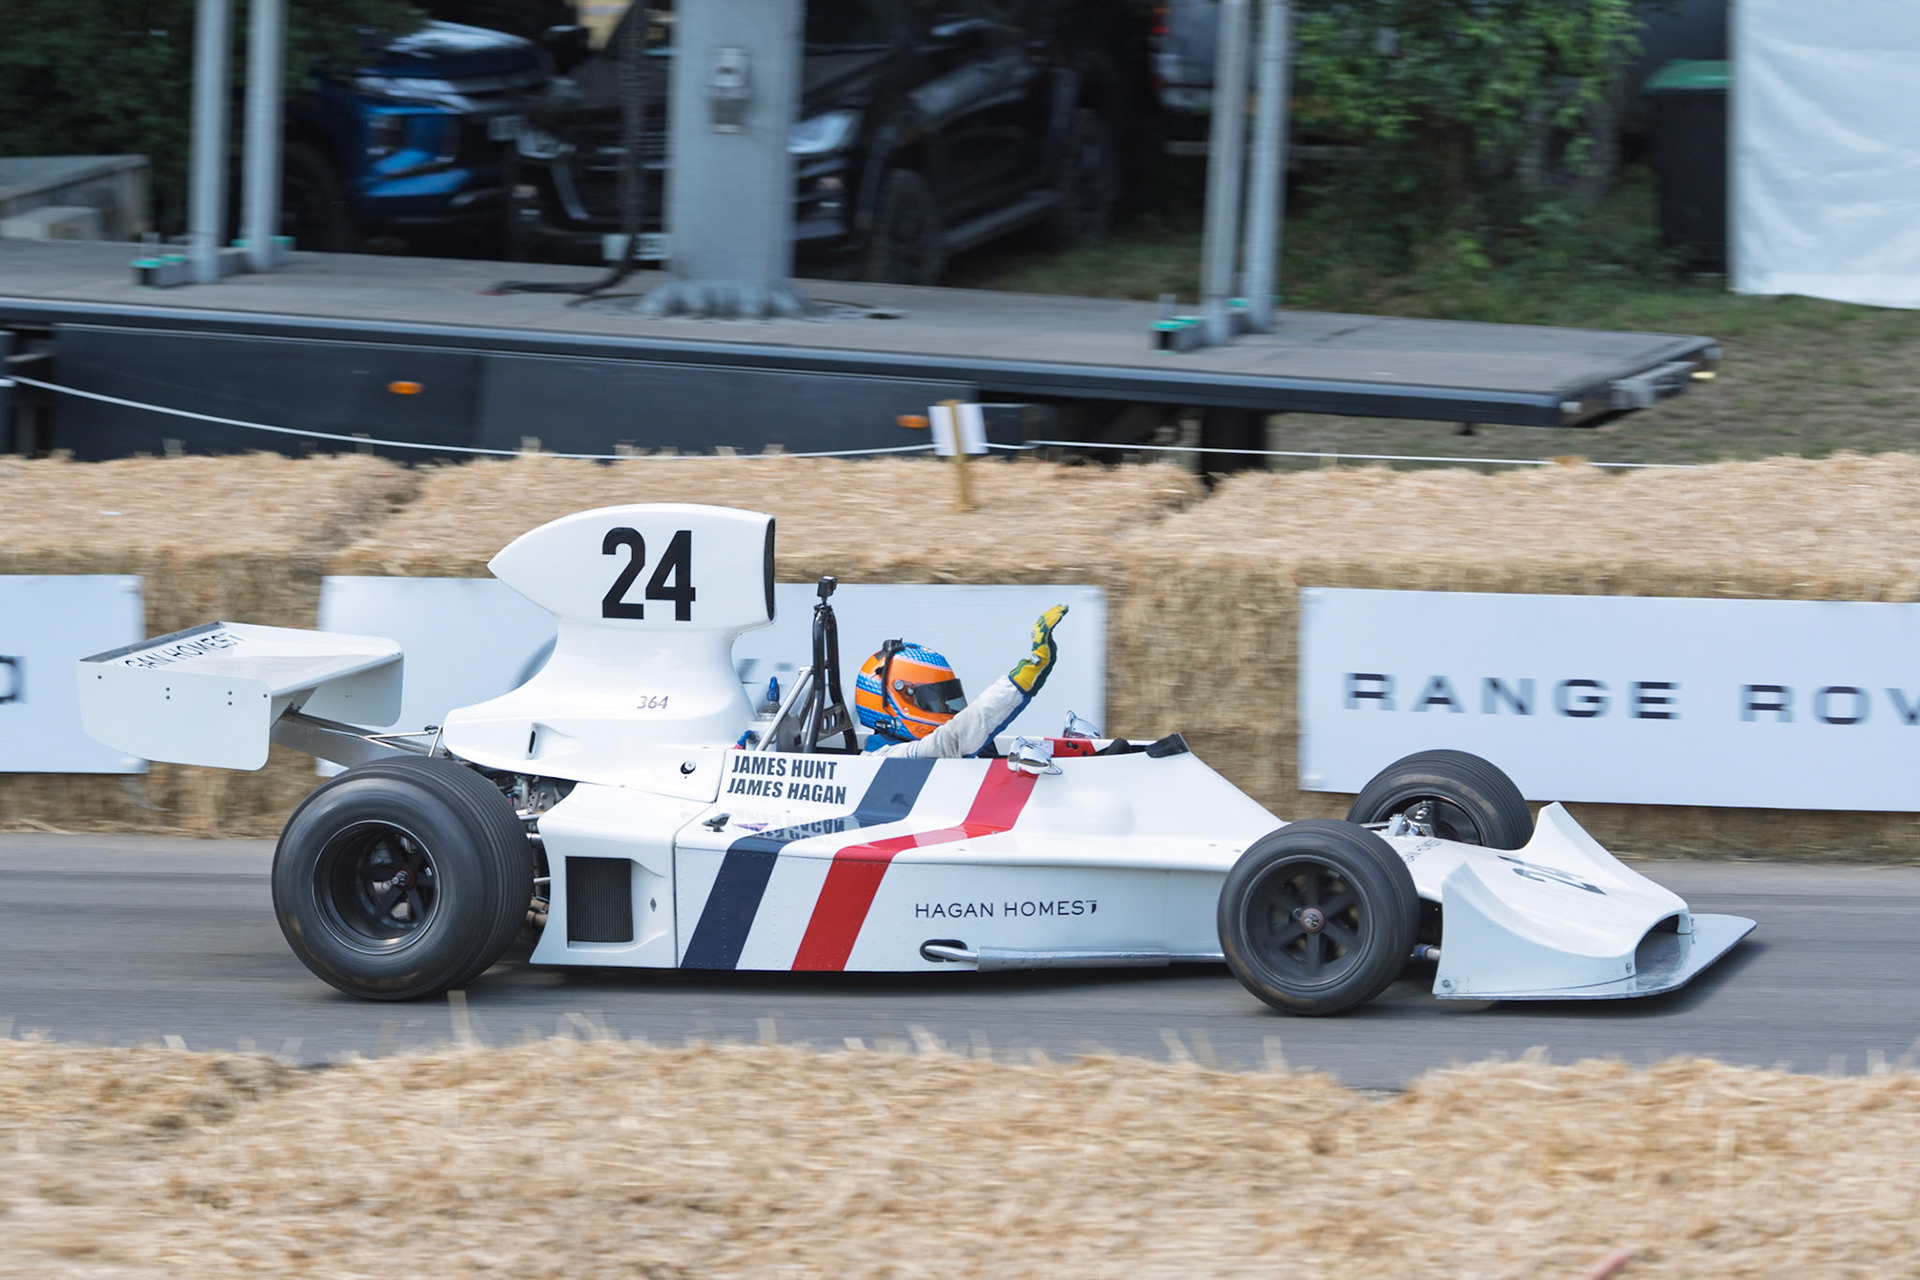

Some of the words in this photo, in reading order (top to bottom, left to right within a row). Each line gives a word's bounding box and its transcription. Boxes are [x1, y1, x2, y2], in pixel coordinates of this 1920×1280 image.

[602, 527, 696, 622] 24
[637, 695, 670, 710] 364
[1342, 672, 1682, 719] RANGE
[732, 755, 786, 777] JAMES
[791, 759, 838, 780] HUNT
[726, 777, 784, 798] JAMES
[787, 782, 847, 805] HAGAN
[915, 902, 994, 918] HAGAN
[1004, 900, 1085, 917] HOMES
